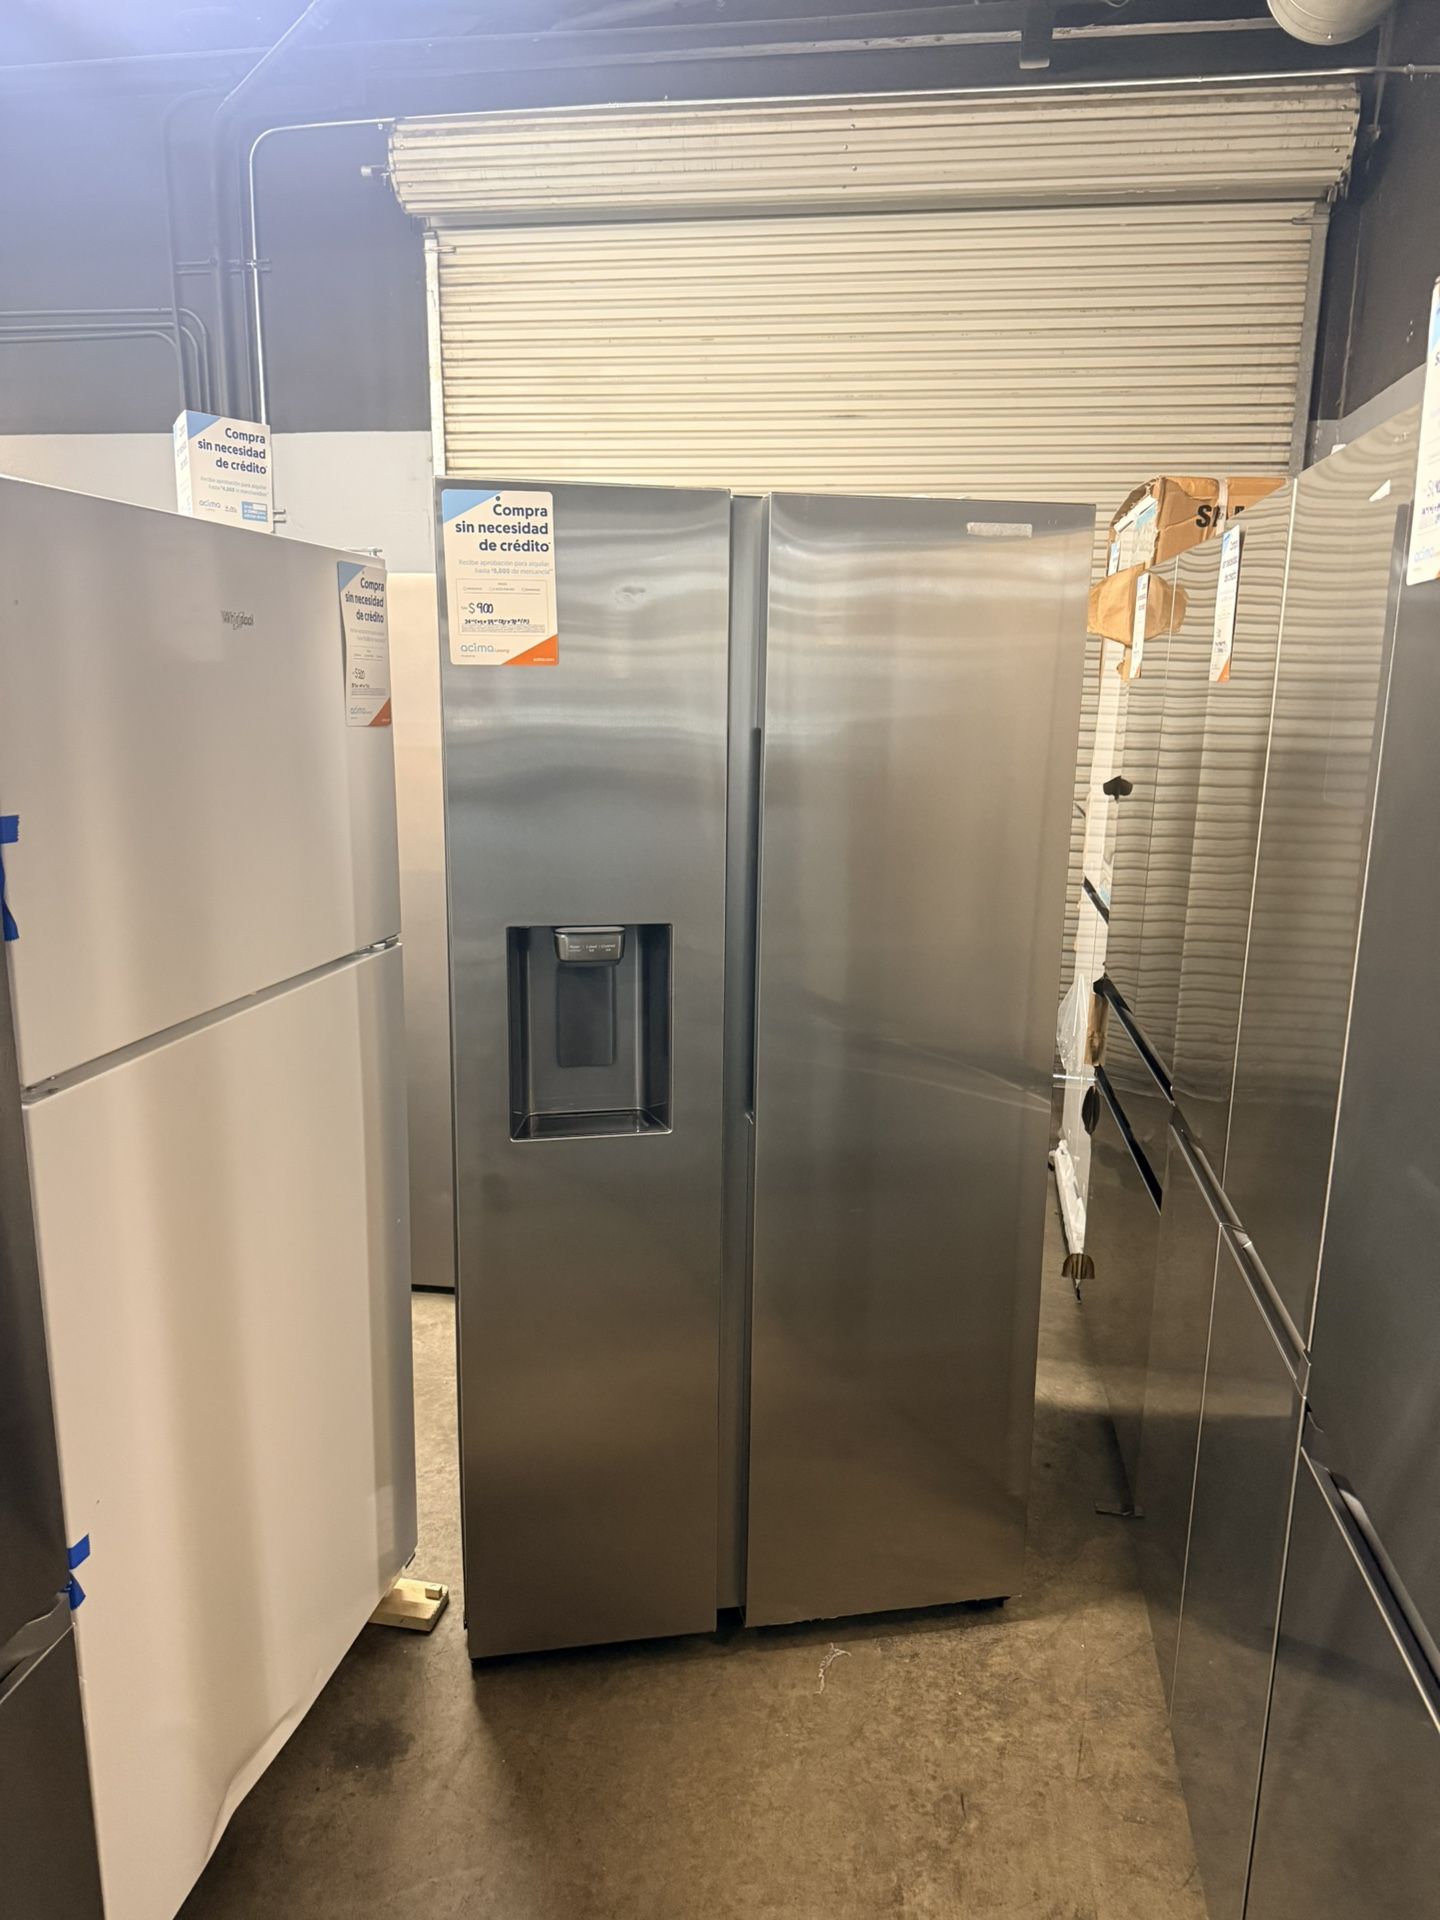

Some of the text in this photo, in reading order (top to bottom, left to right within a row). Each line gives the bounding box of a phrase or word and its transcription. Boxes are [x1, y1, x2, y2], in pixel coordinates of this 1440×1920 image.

[225, 427, 266, 444] Compra
[198, 439, 266, 459] sin necesidad
[216, 457, 229, 469] de
[492, 503, 548, 519] Compra
[455, 521, 548, 535] sin necesidad
[479, 539, 497, 551] de
[360, 577, 384, 593] Compra
[345, 591, 384, 608] sin necesidad
[356, 609, 364, 621] de
[460, 643, 494, 653] acima
